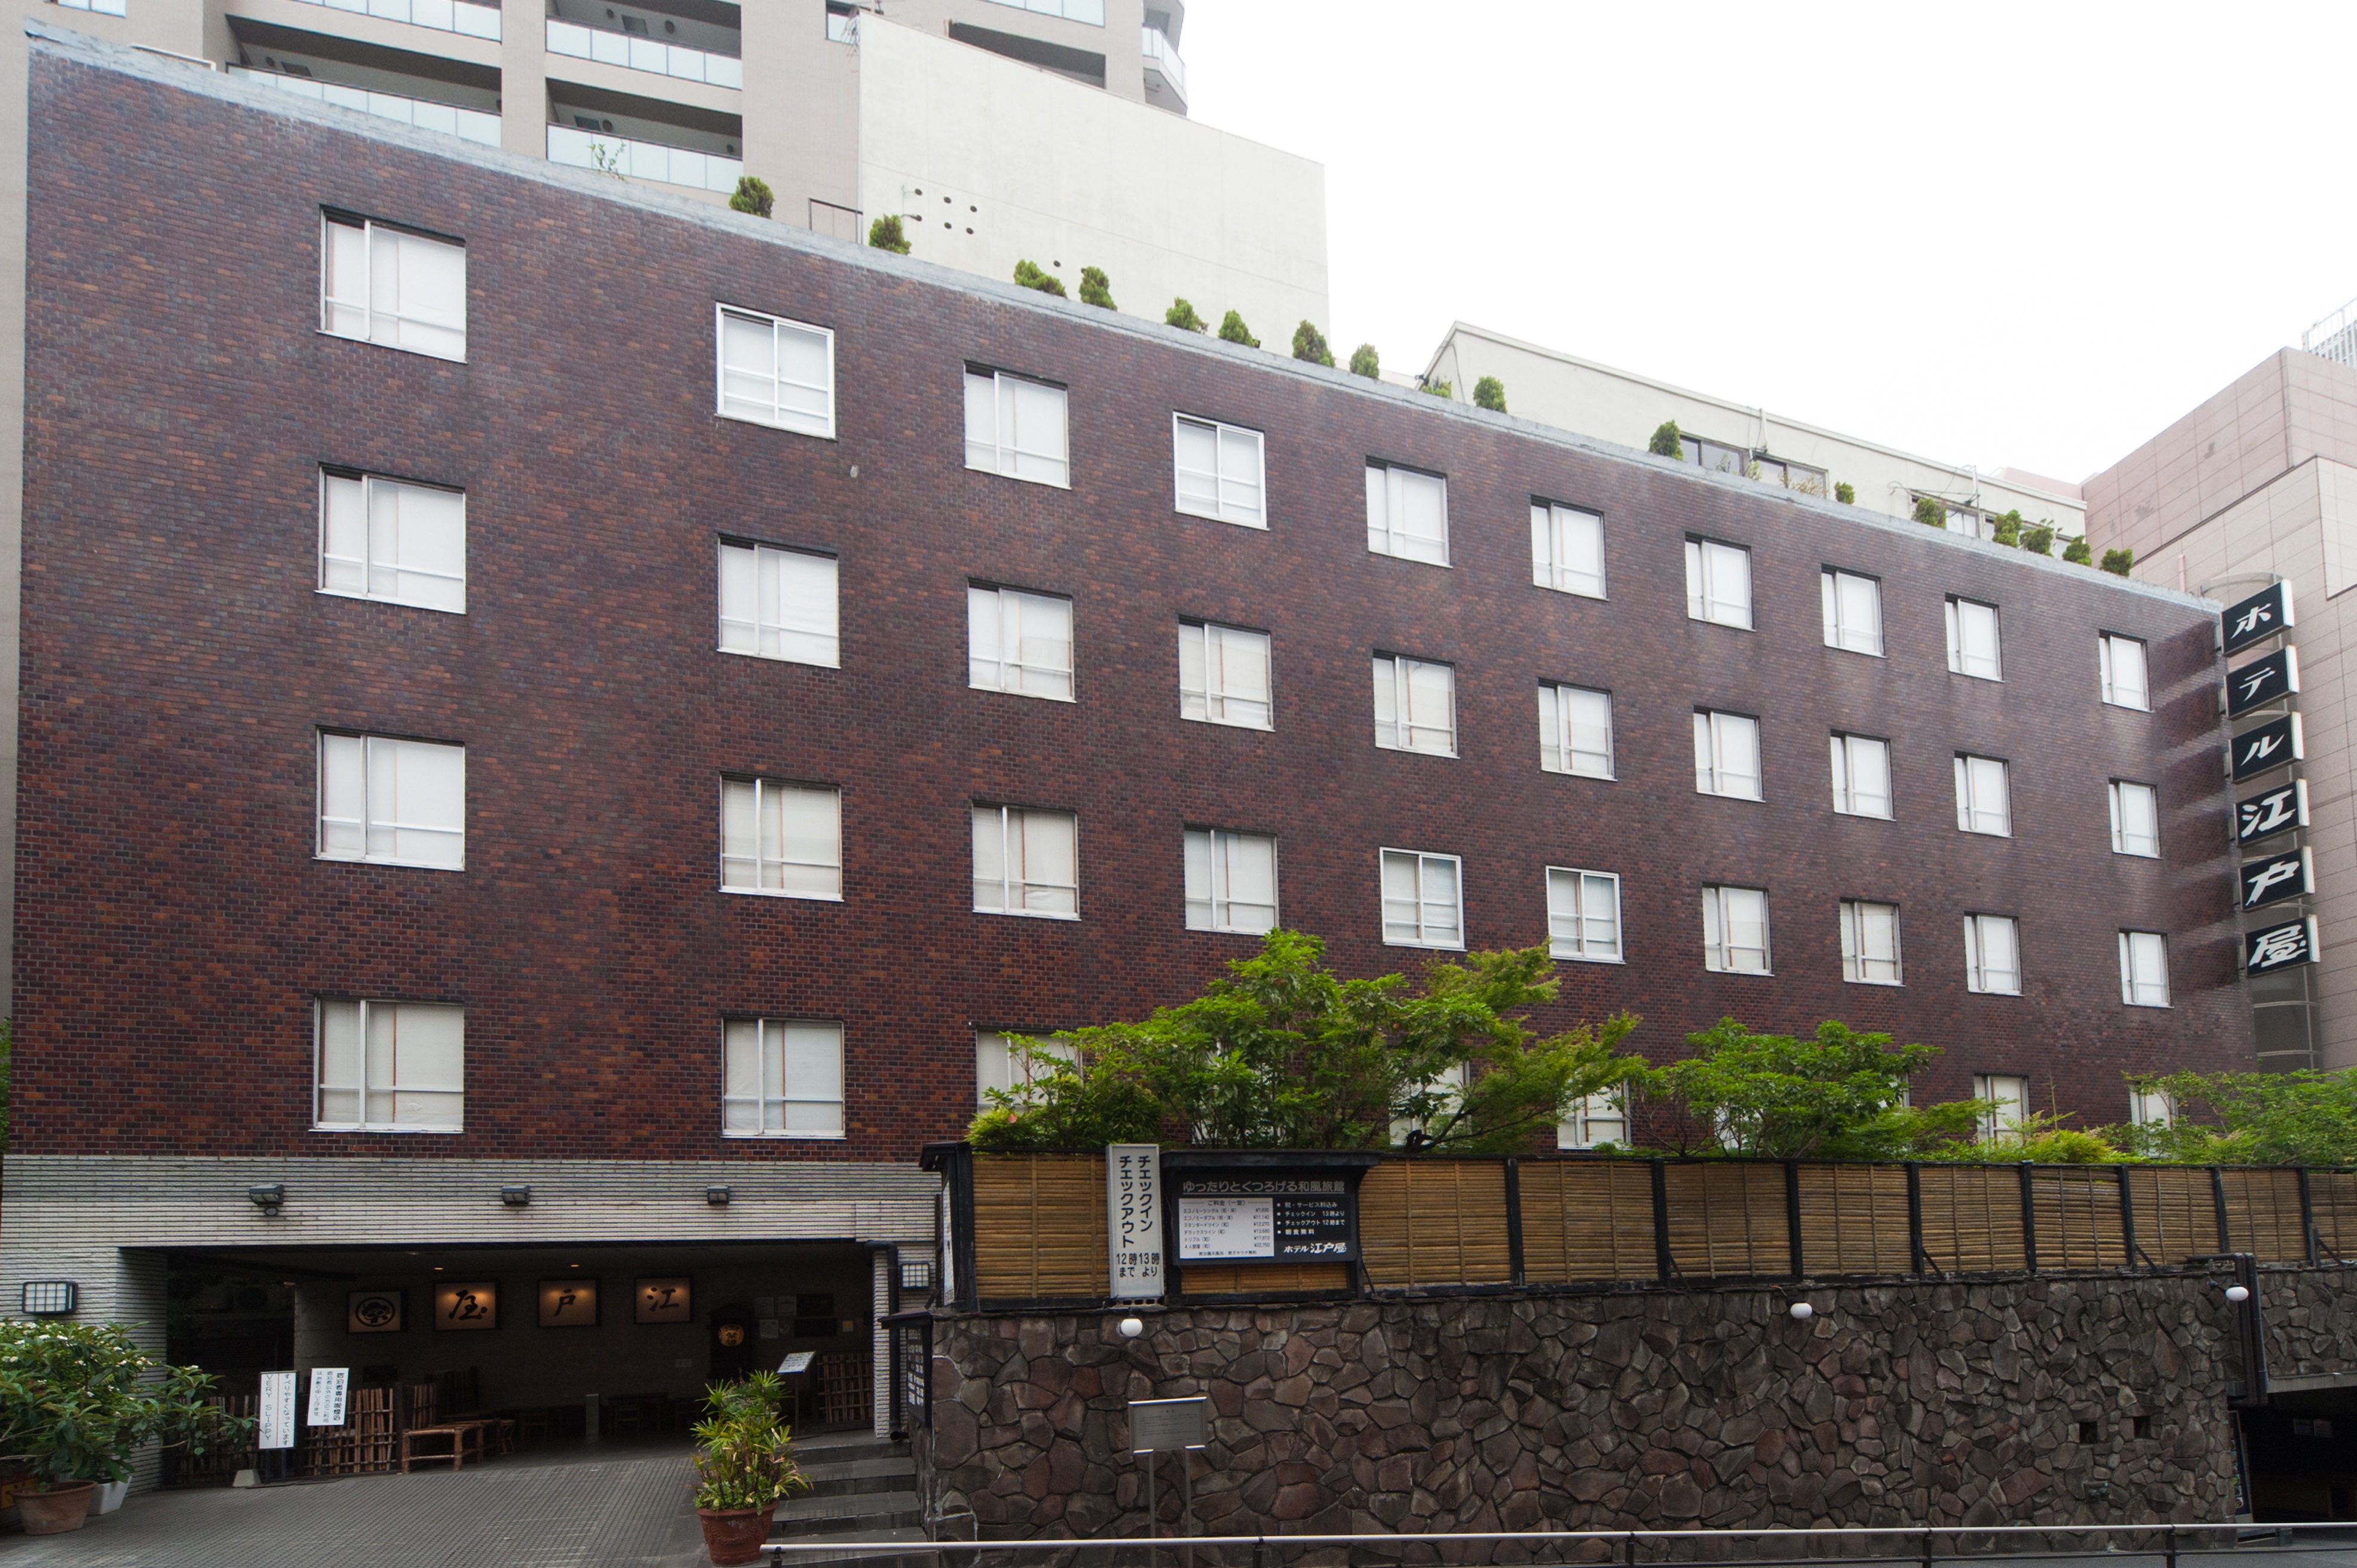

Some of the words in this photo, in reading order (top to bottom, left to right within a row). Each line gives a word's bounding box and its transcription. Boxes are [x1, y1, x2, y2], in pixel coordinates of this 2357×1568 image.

[1183, 1180, 1345, 1192] ゆったりとくつろげる和風旅館
[1138, 1155, 1153, 1232] チェックイン
[1119, 1155, 1135, 1248] チェックアウト
[1116, 1252, 1137, 1265] 12時
[1139, 1252, 1160, 1265] 13時
[1119, 1266, 1135, 1277] まで
[1142, 1266, 1158, 1277] より
[283, 1373, 292, 1446] すべりやすくなっています
